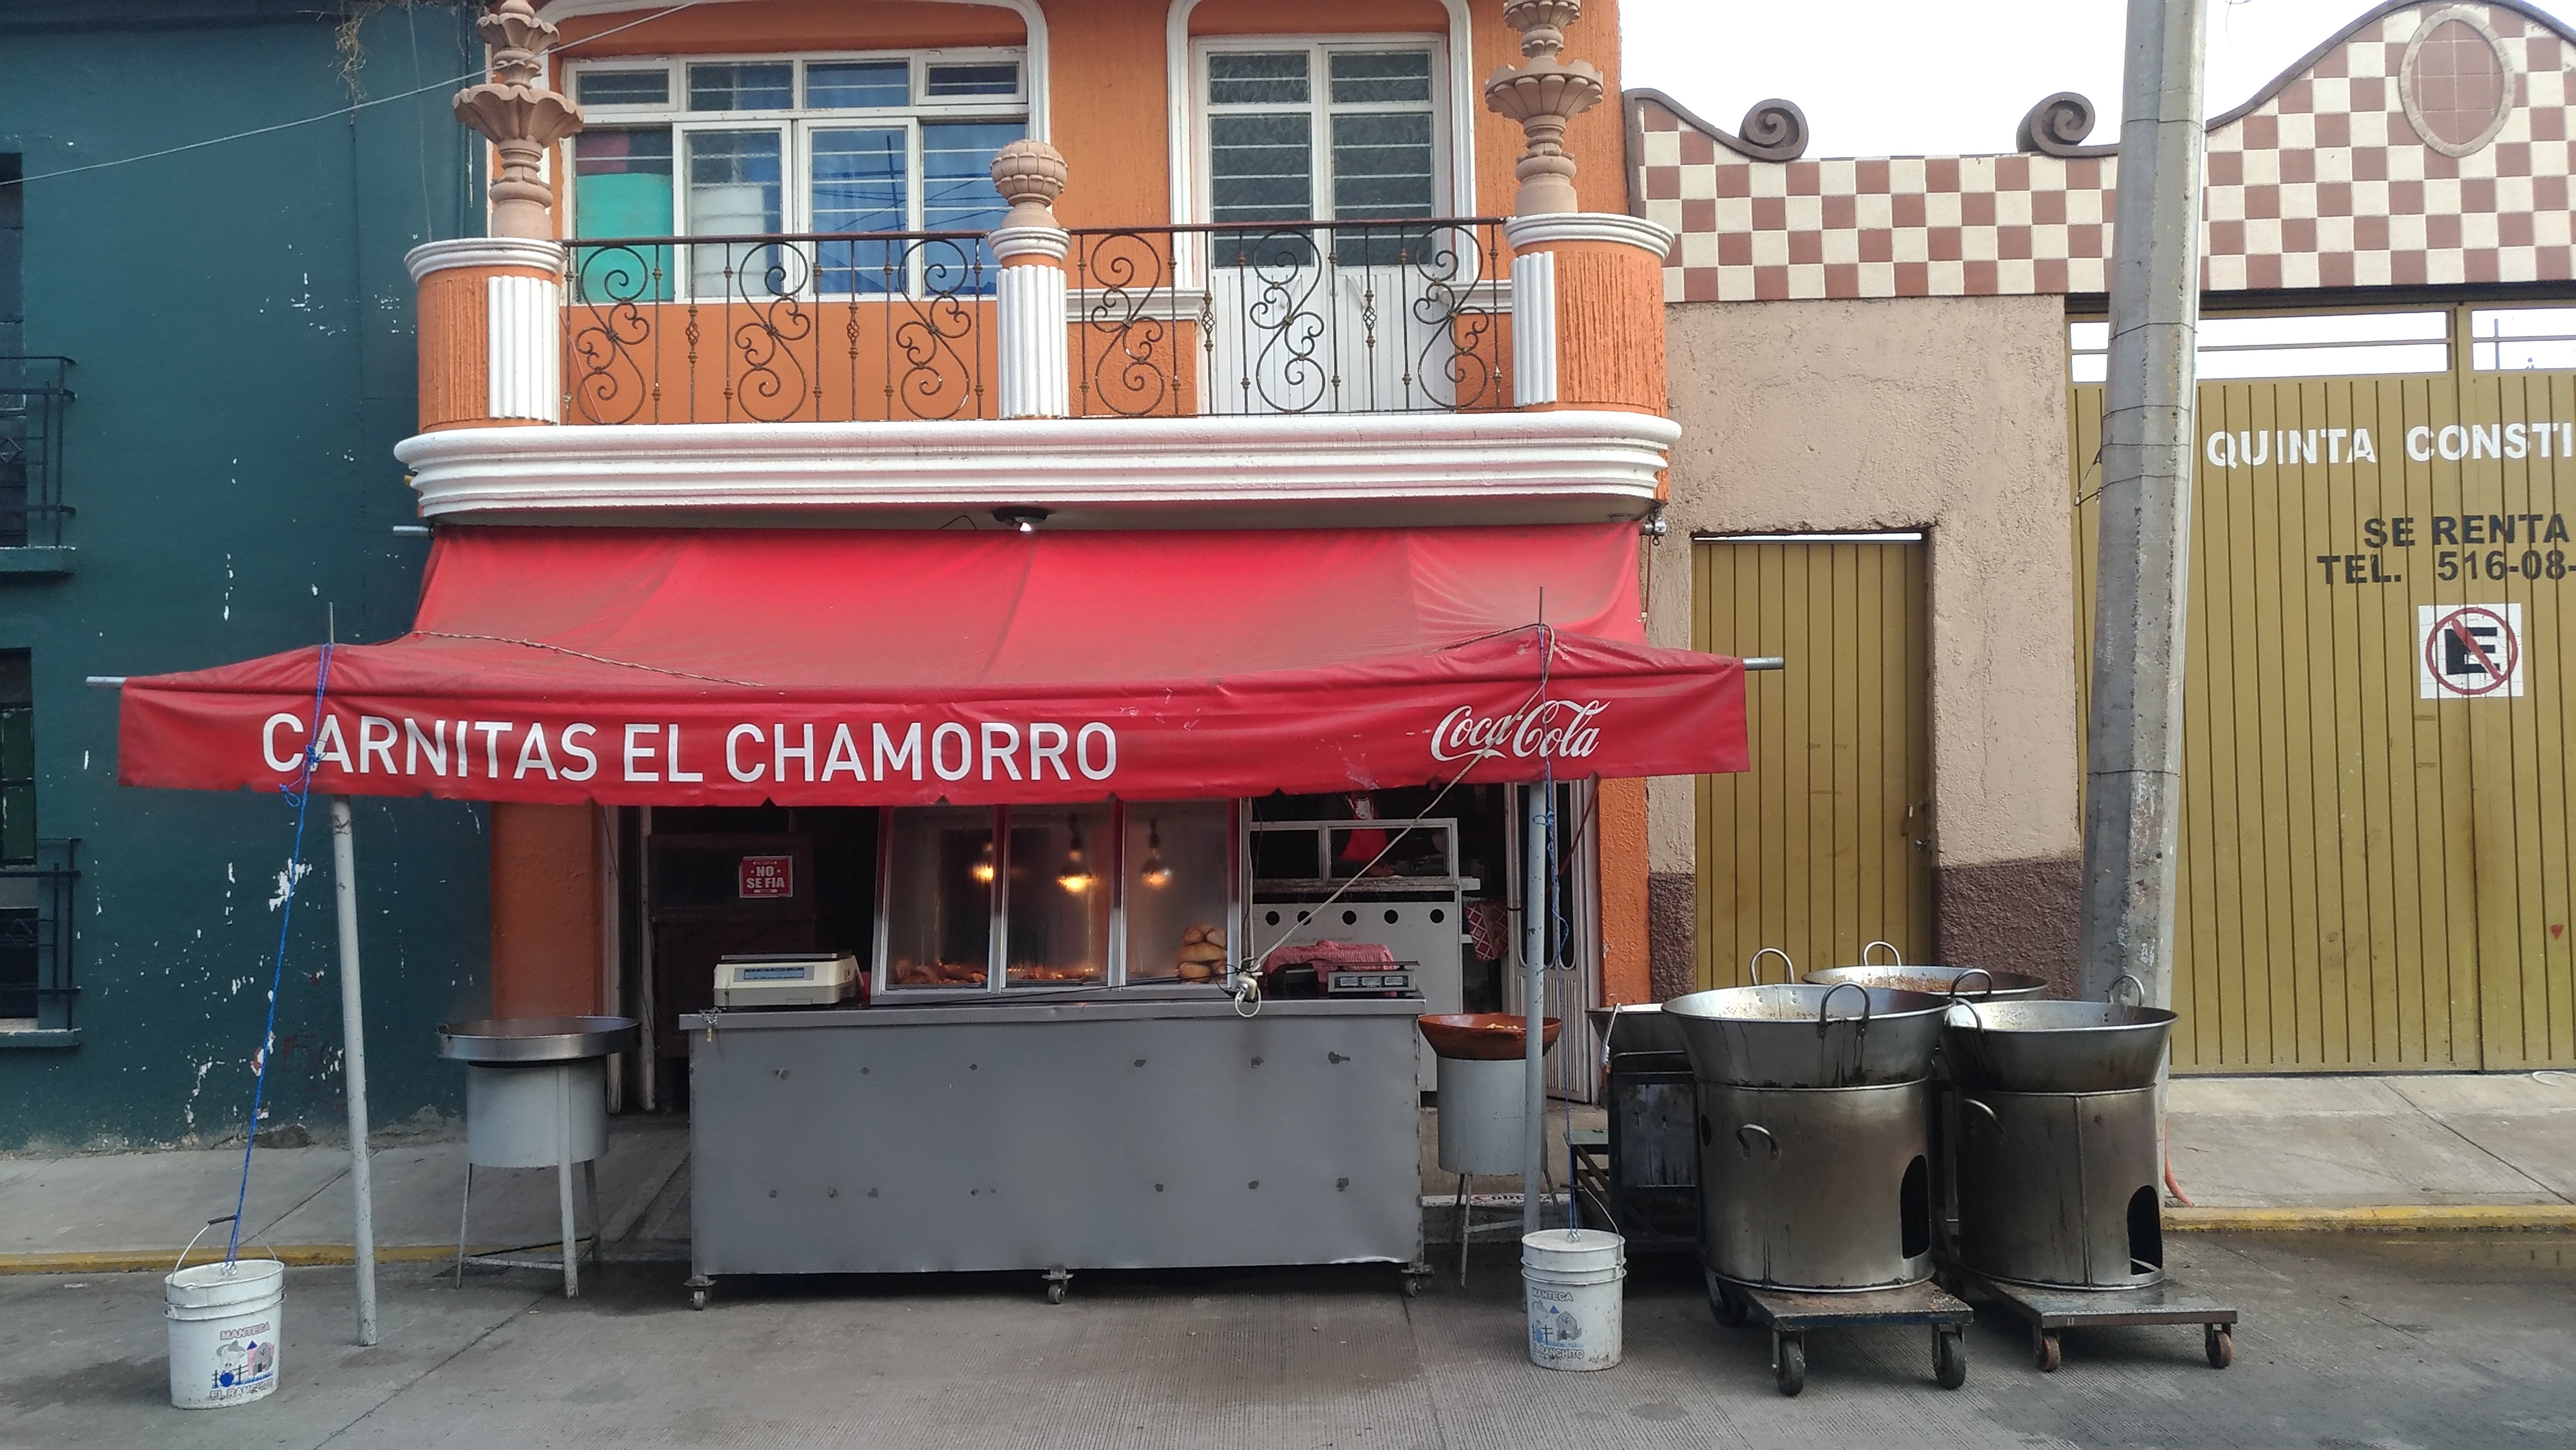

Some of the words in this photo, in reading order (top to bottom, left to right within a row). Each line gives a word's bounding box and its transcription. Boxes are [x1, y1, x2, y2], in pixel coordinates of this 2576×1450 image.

[2206, 428, 2376, 469] QUINTA
[2407, 422, 2573, 462] CONSTI
[2364, 517, 2416, 548] SE
[2432, 514, 2570, 545] RENTA
[2317, 554, 2402, 584] TEL.
[262, 712, 598, 782] CARNITAS
[624, 723, 703, 782] EL
[726, 721, 1118, 783] CHAMORRO
[756, 866, 775, 877] NO
[746, 878, 762, 889] SE
[765, 877, 785, 888] FIA
[1531, 1287, 1573, 1302] MANTECA
[220, 1321, 270, 1340] MANTECA
[1539, 1345, 1585, 1360] RANCHITO
[210, 1390, 226, 1400] EL
